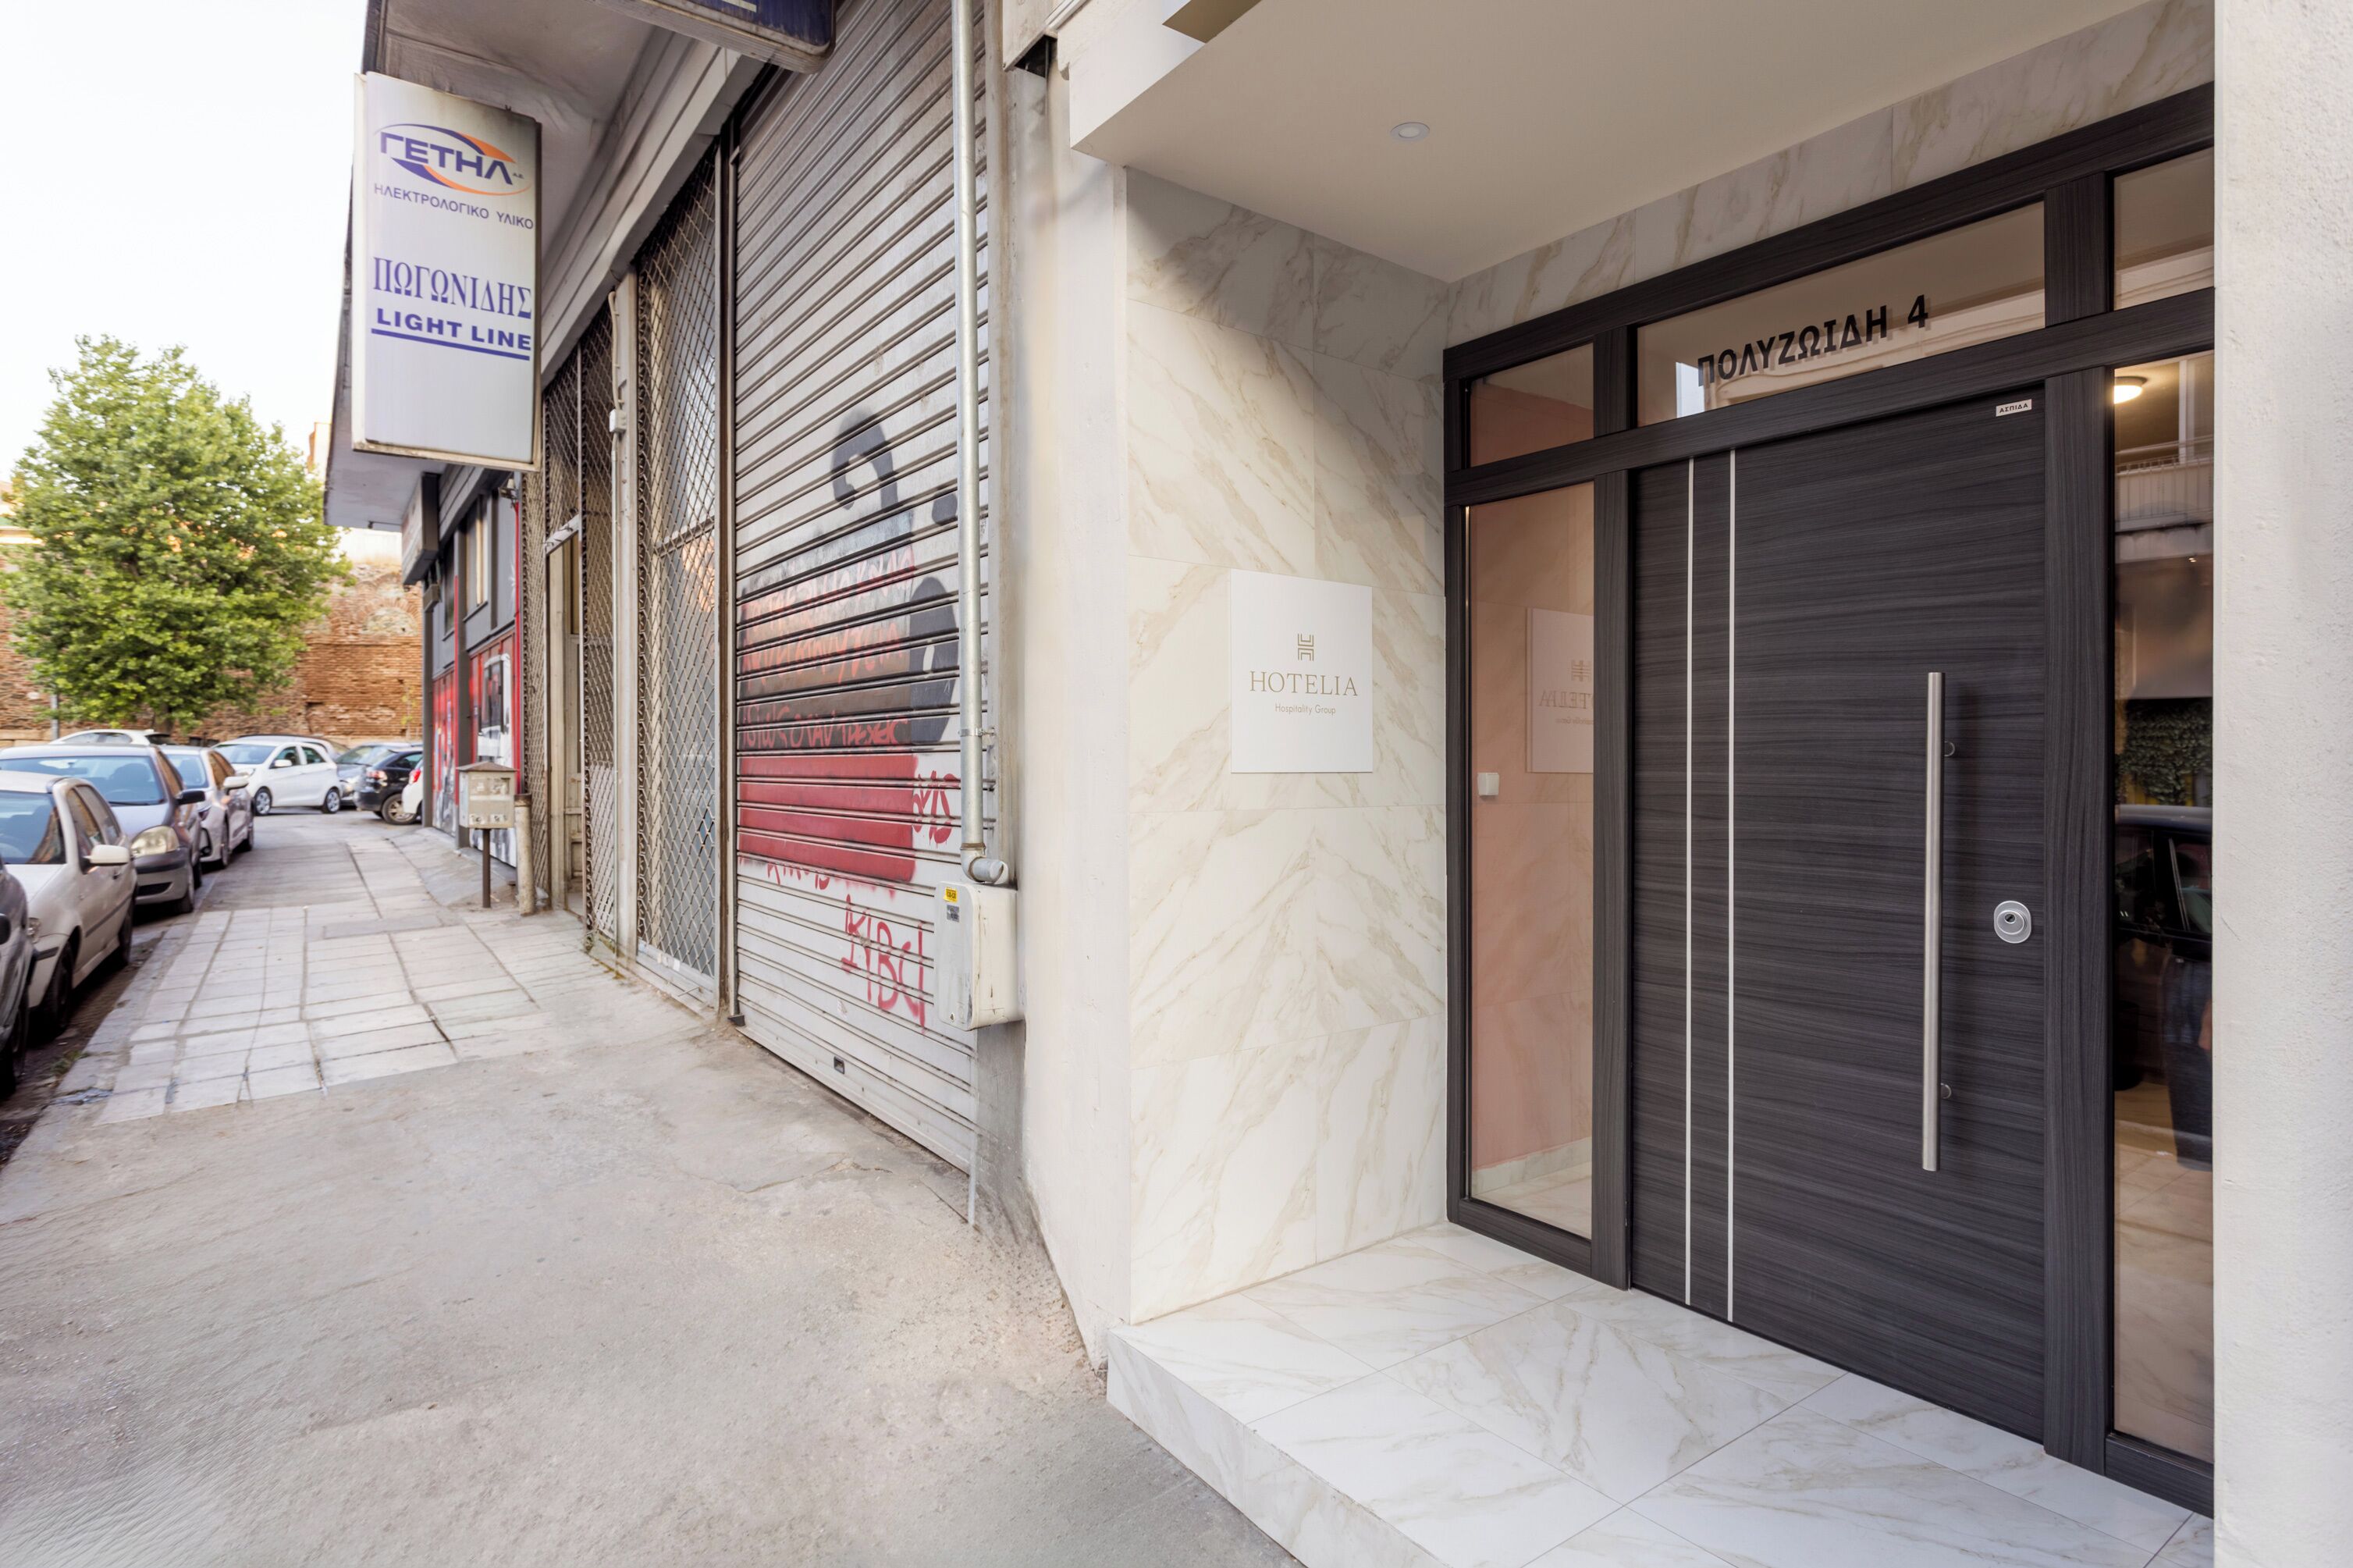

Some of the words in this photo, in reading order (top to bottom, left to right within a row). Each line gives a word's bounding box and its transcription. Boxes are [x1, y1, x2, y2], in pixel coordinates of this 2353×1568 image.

[381, 132, 513, 185] ΓΕΤΗΛ
[375, 183, 489, 219] ΗΛΕΚΤΡΟΛΟΓΙΚΟ
[496, 212, 534, 229] ΥΛΙΚΟ
[373, 257, 531, 319] ΠΩΓΩΝΙΔΗΣ
[377, 308, 462, 338] LIGHT
[471, 325, 531, 351] LINE
[1698, 304, 1887, 386] ΠΟΛΥΖΩΙΔΗ
[1907, 294, 1928, 329] 4
[1999, 403, 2028, 413] ΑΣΠΙΔΑ
[1249, 670, 1358, 696] HOTELIA
[1275, 703, 1313, 715] Hospitality
[1315, 705, 1336, 716] Group
